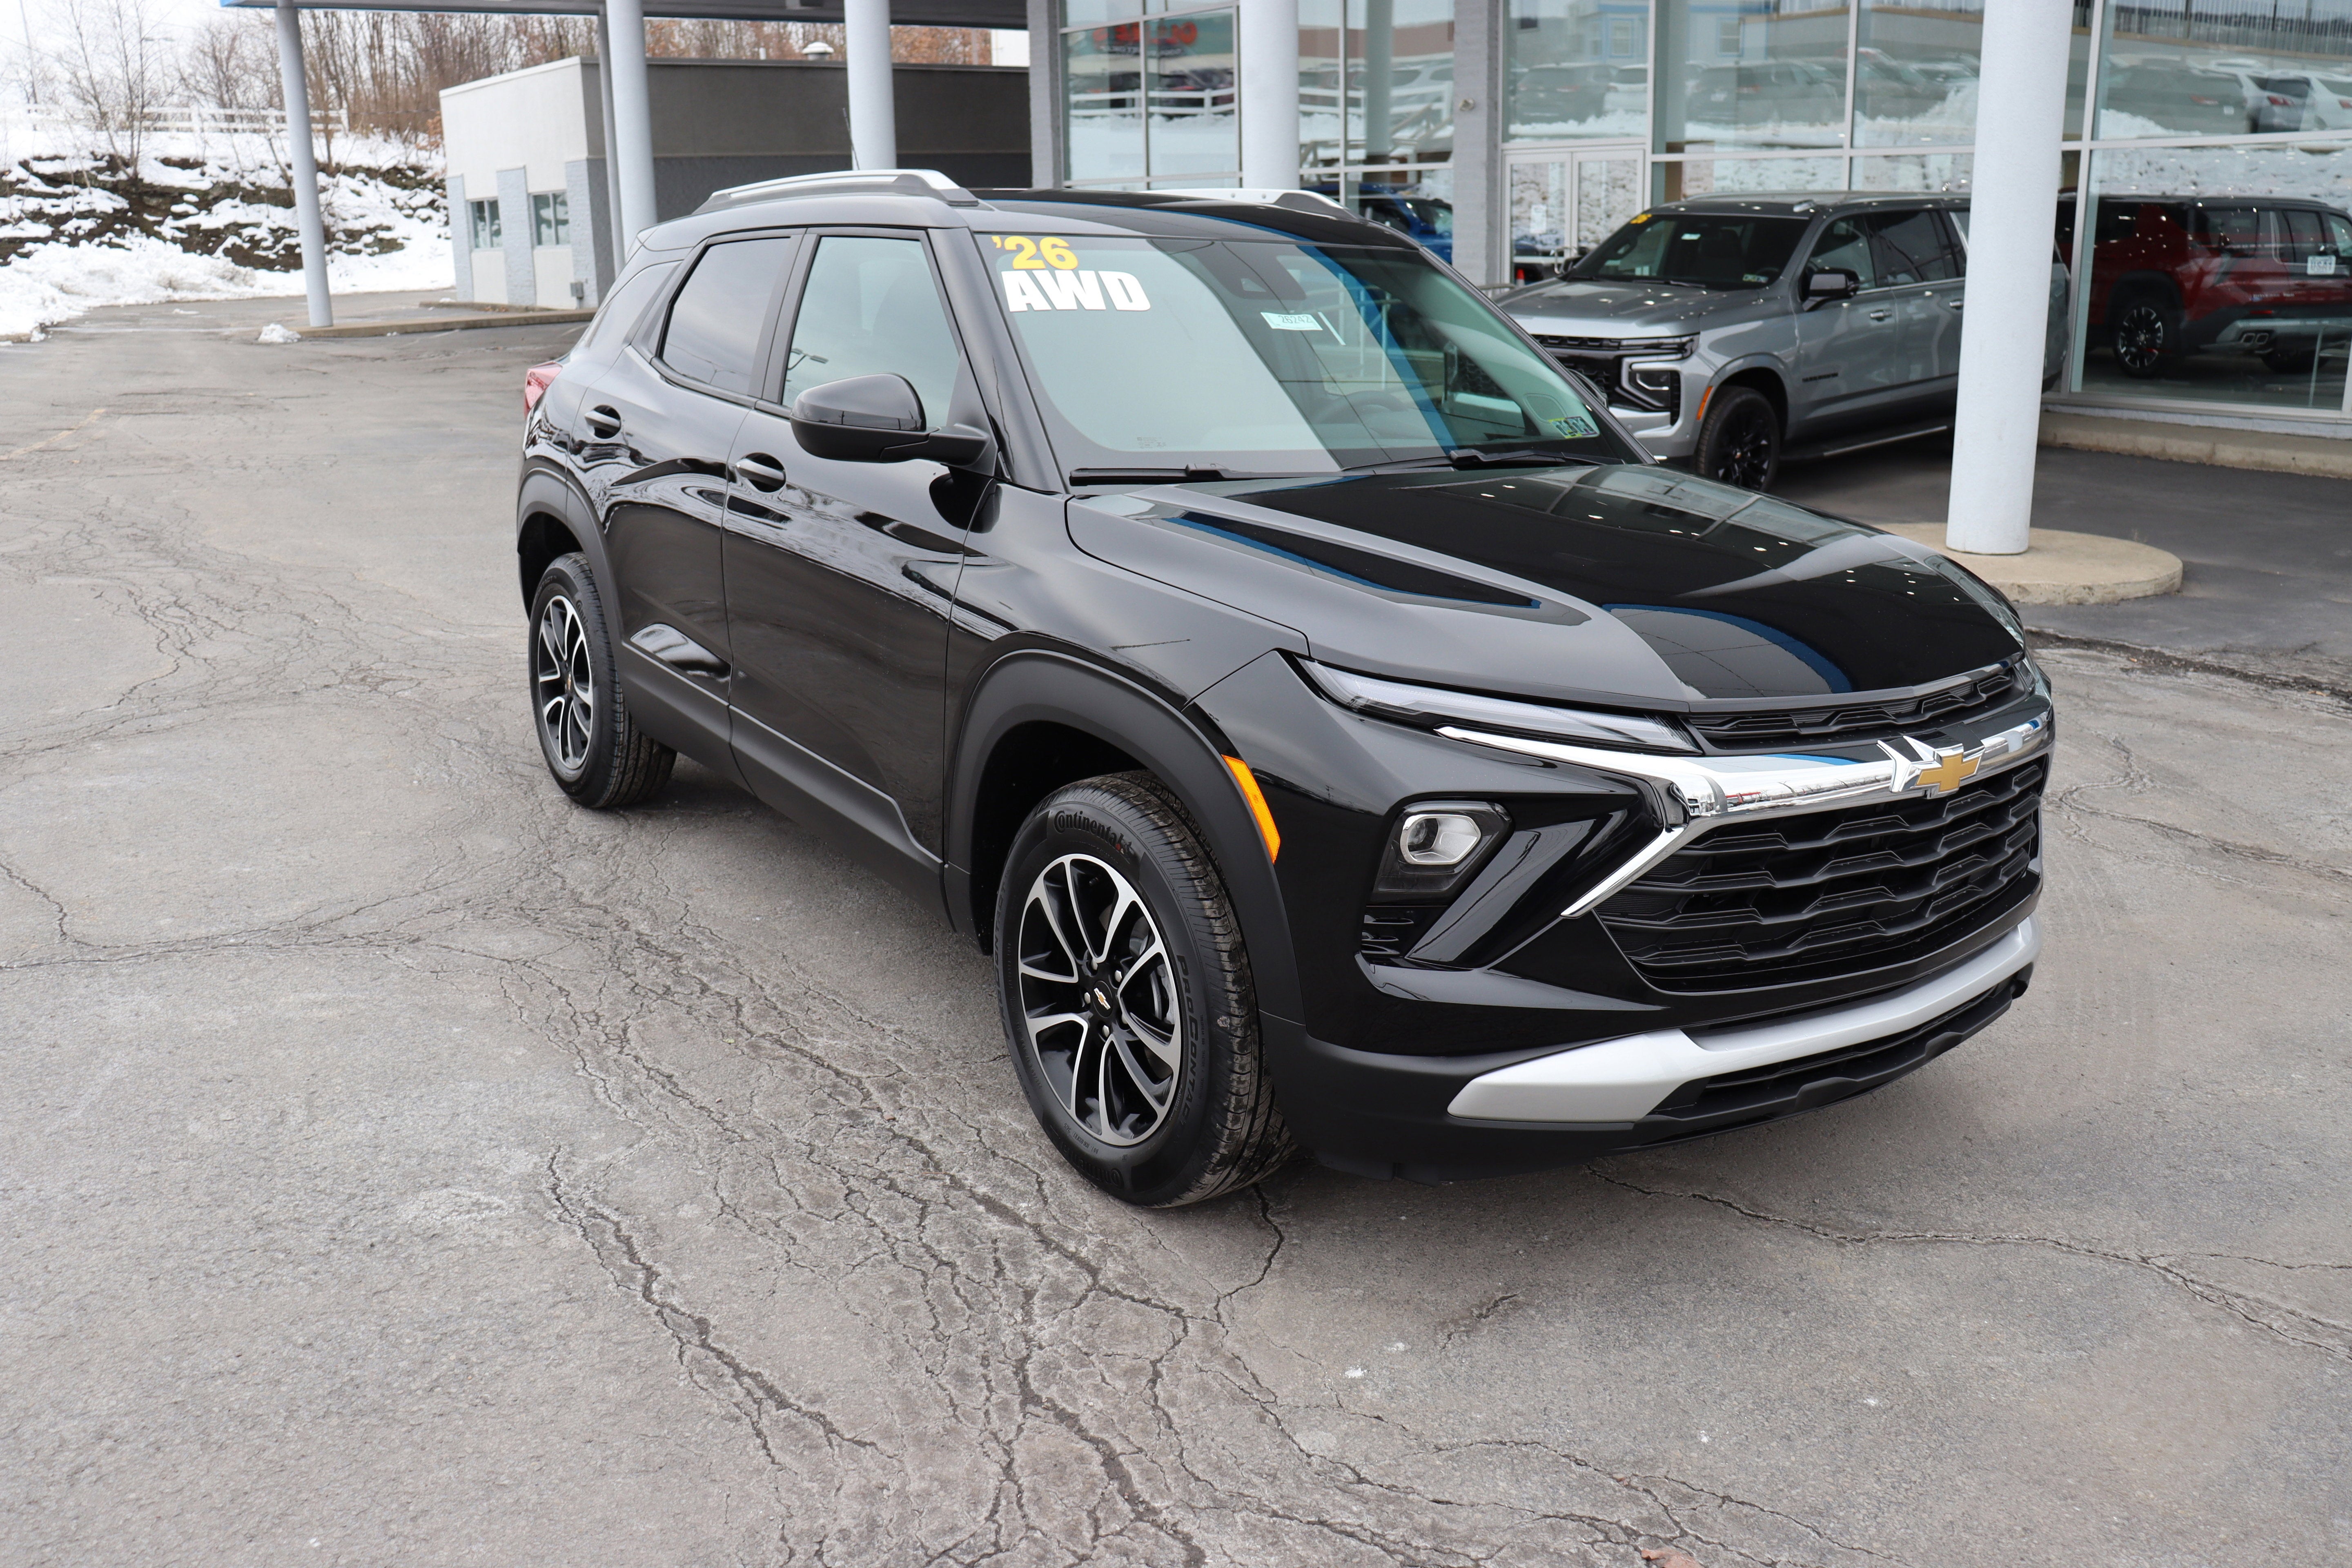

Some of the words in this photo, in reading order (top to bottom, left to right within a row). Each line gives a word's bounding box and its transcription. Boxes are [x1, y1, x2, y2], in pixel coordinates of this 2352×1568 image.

[1001, 270, 1151, 312] AWD
[1278, 315, 1313, 324] 26242
[1054, 810, 1124, 848] Continental
